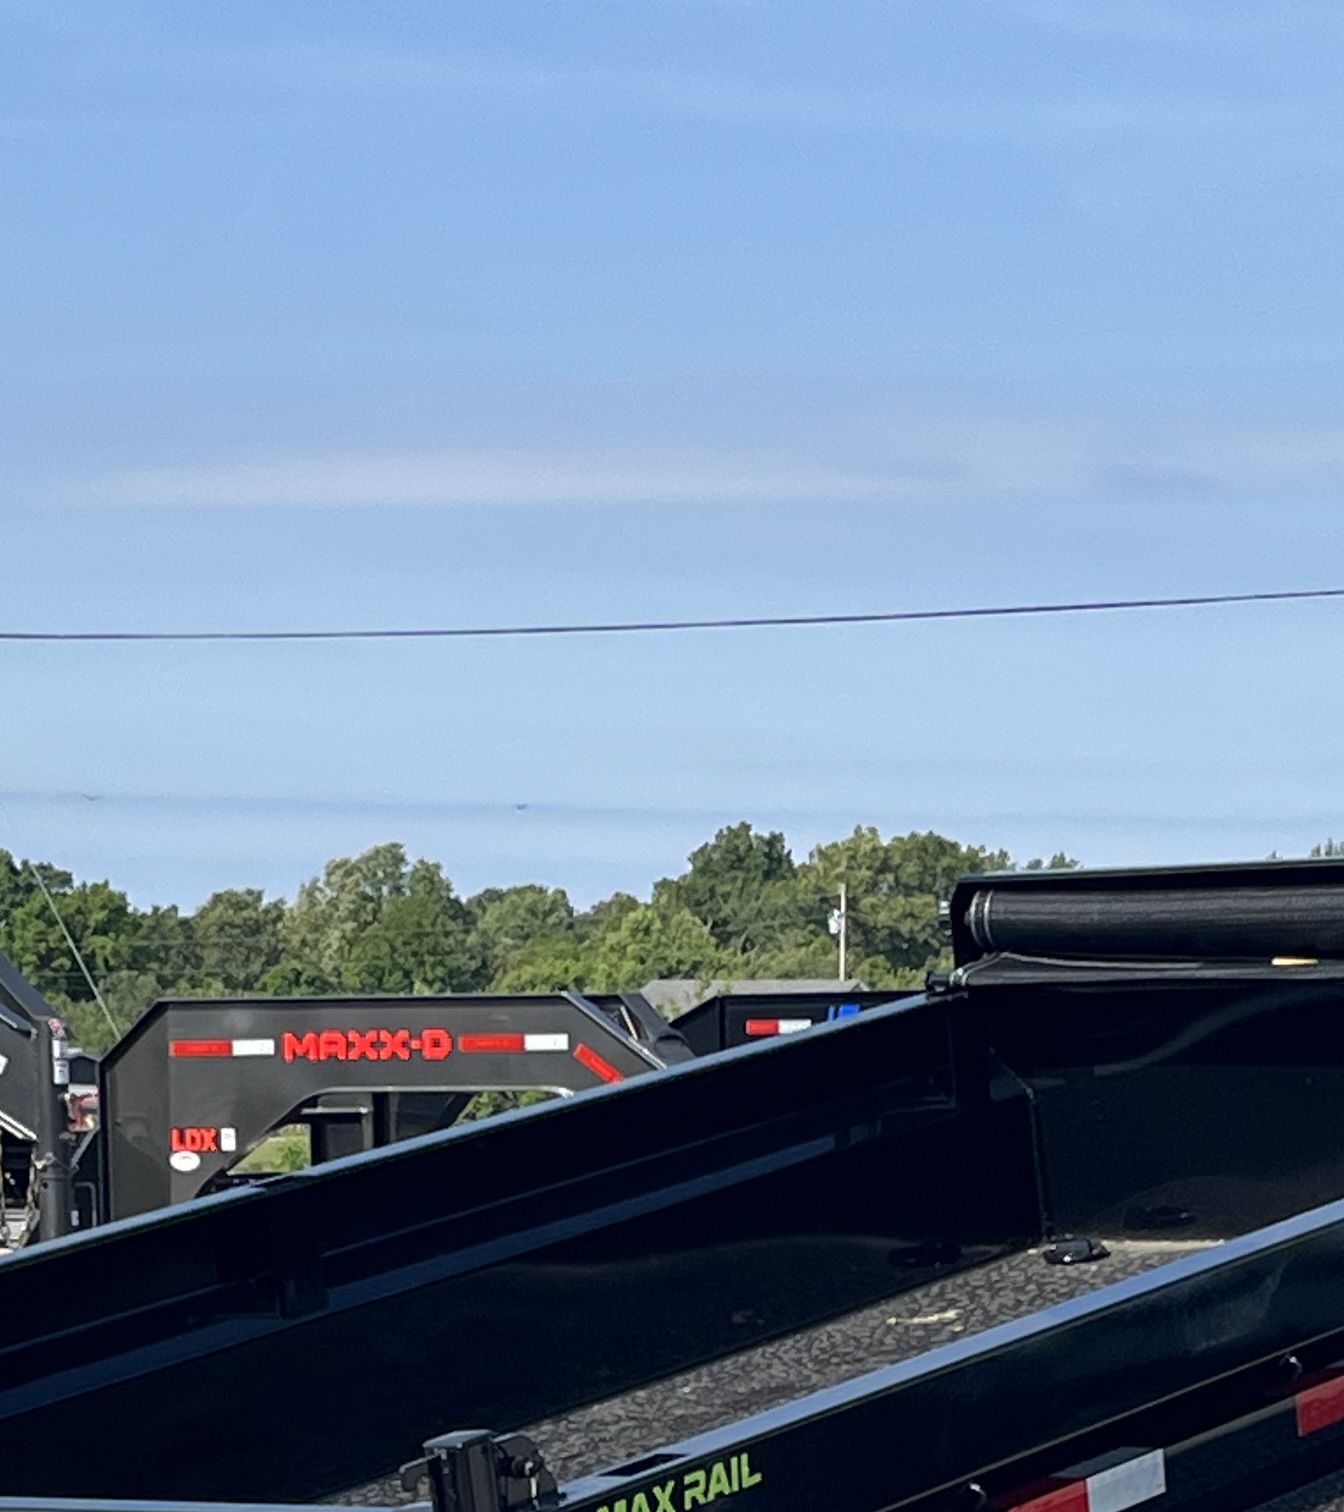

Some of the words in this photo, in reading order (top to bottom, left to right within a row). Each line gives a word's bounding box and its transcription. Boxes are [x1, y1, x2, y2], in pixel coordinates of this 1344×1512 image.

[283, 1027, 452, 1063] MAXX-D
[171, 1127, 218, 1152] LDX
[683, 1453, 762, 1511] RAIL
